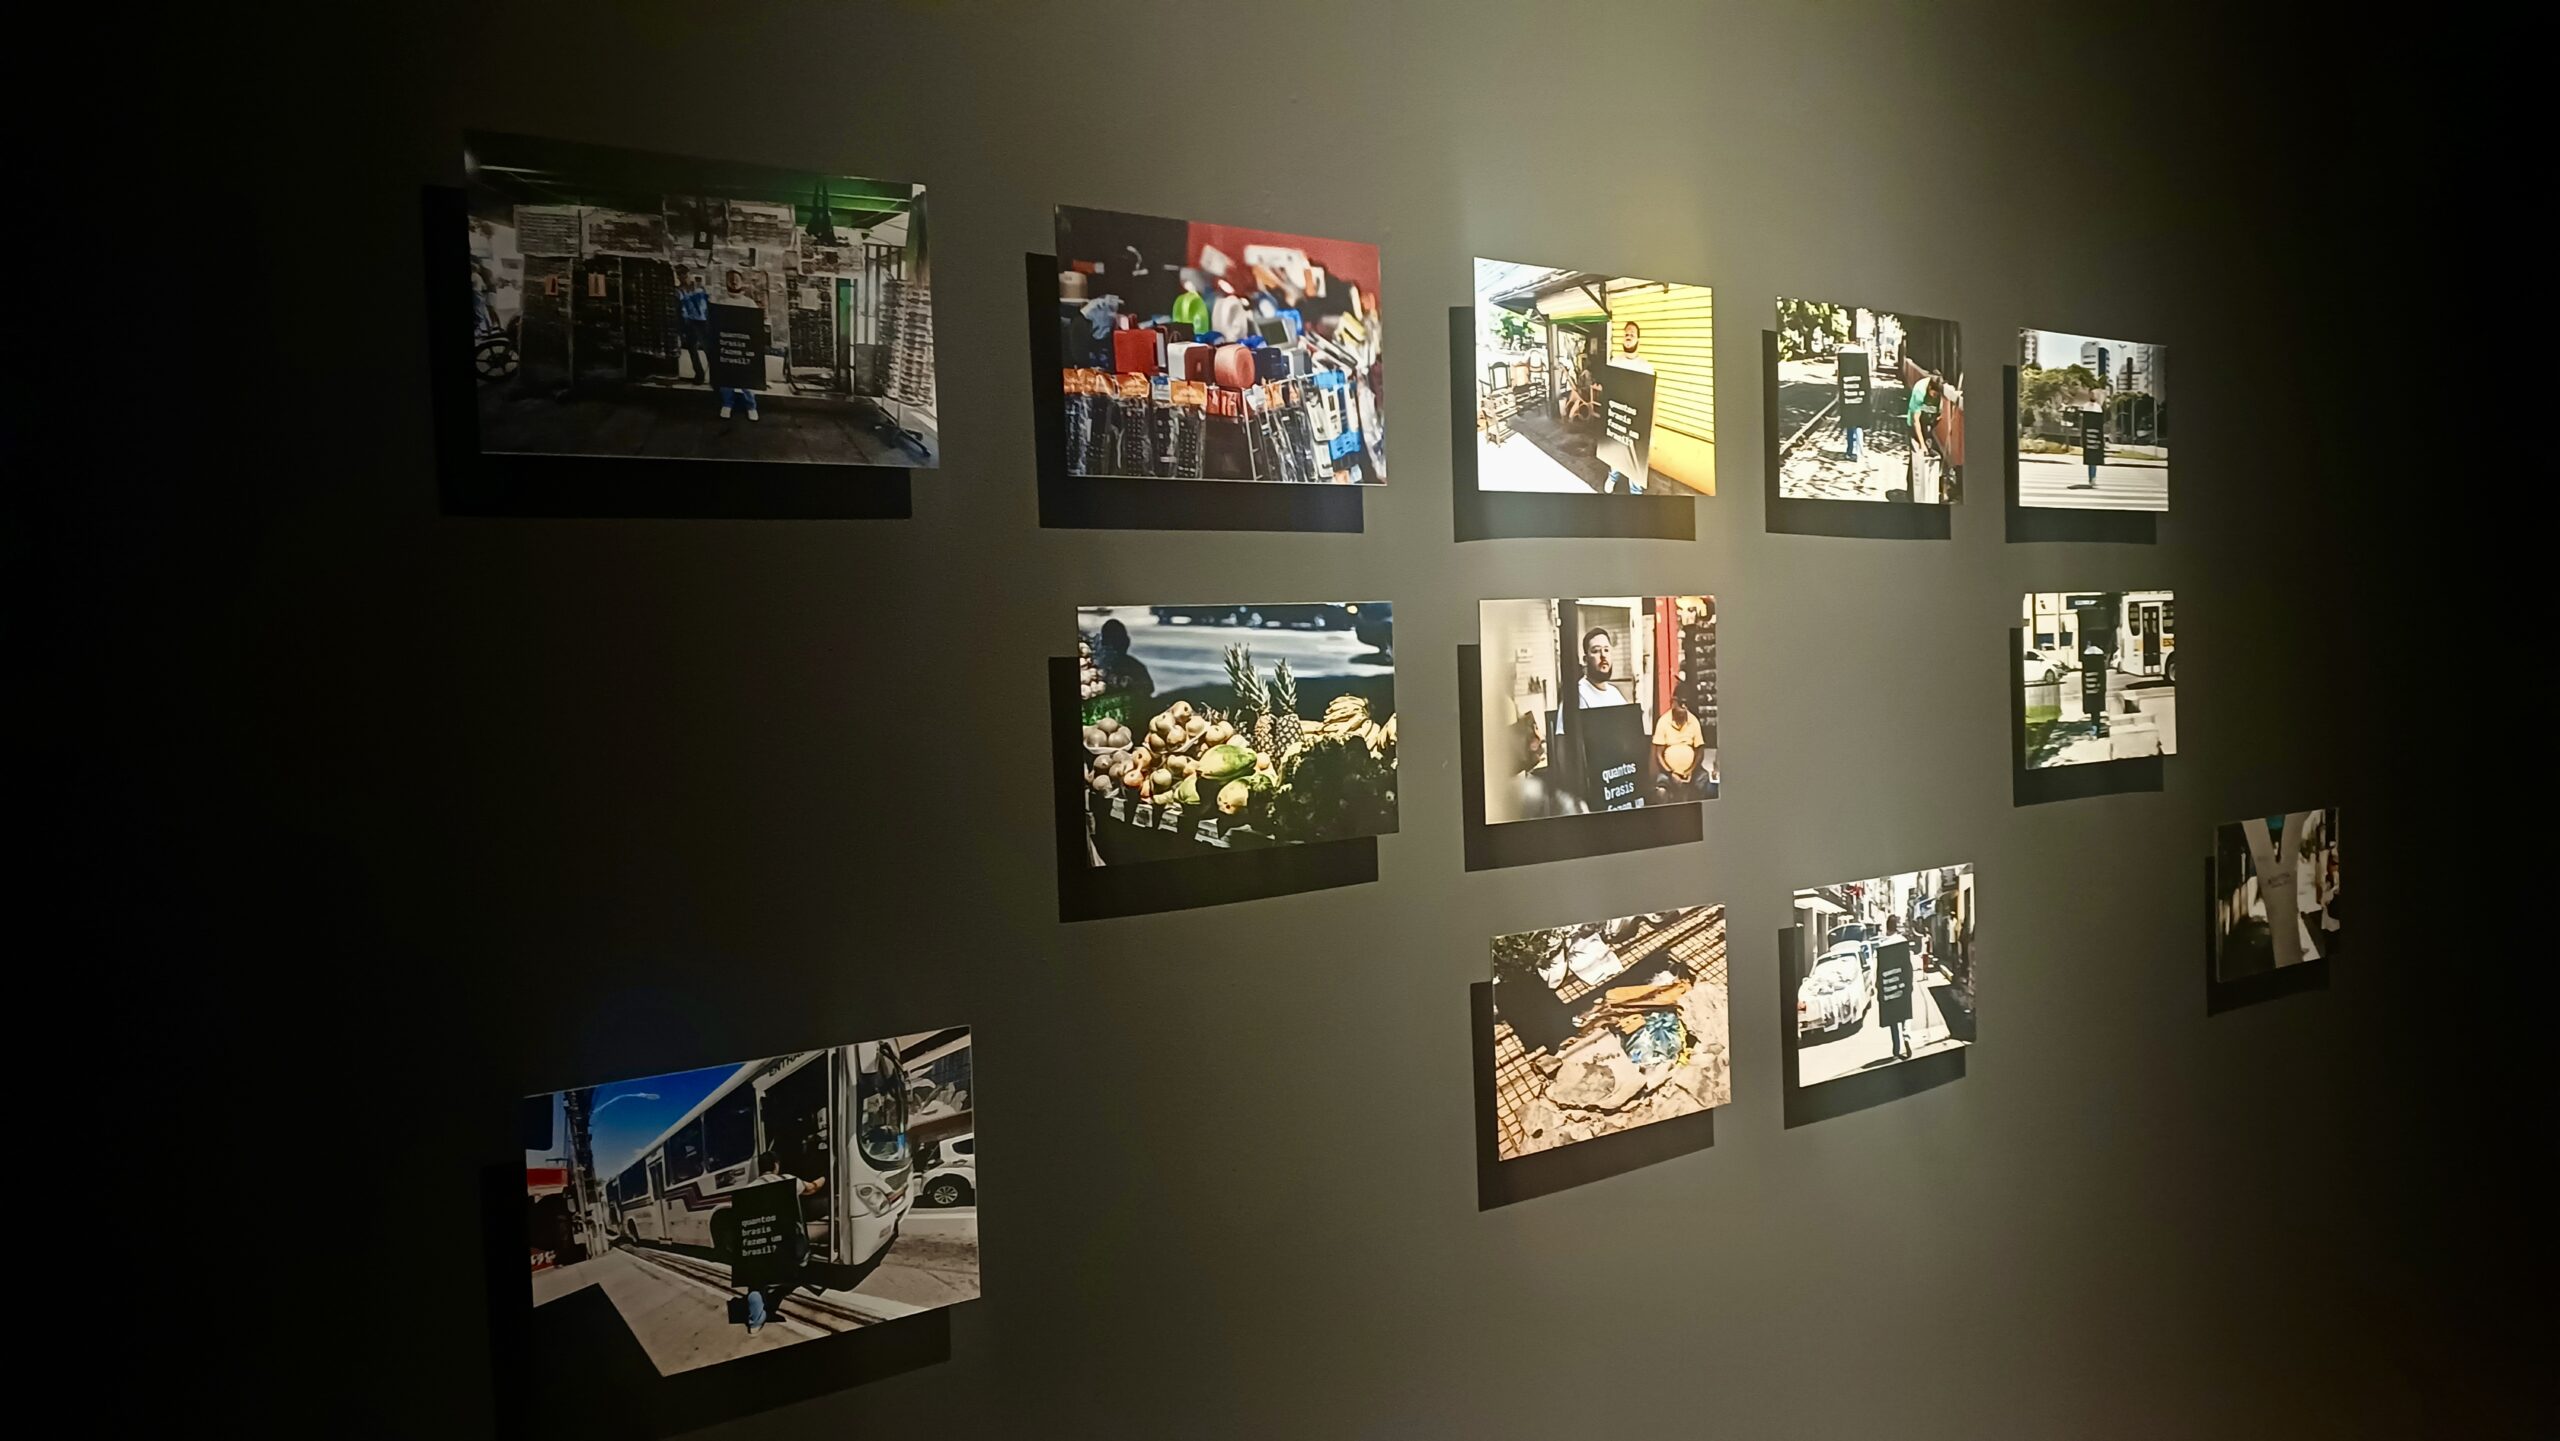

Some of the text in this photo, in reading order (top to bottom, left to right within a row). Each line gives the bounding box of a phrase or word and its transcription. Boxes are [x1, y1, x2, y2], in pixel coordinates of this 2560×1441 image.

[1602, 763, 1637, 784] quantos
[1604, 781, 1635, 800] brasis
[741, 1215, 777, 1228] quantos
[741, 1226, 772, 1237] brasis
[742, 1238, 767, 1246] fazem
[742, 1245, 777, 1257] brasil?
